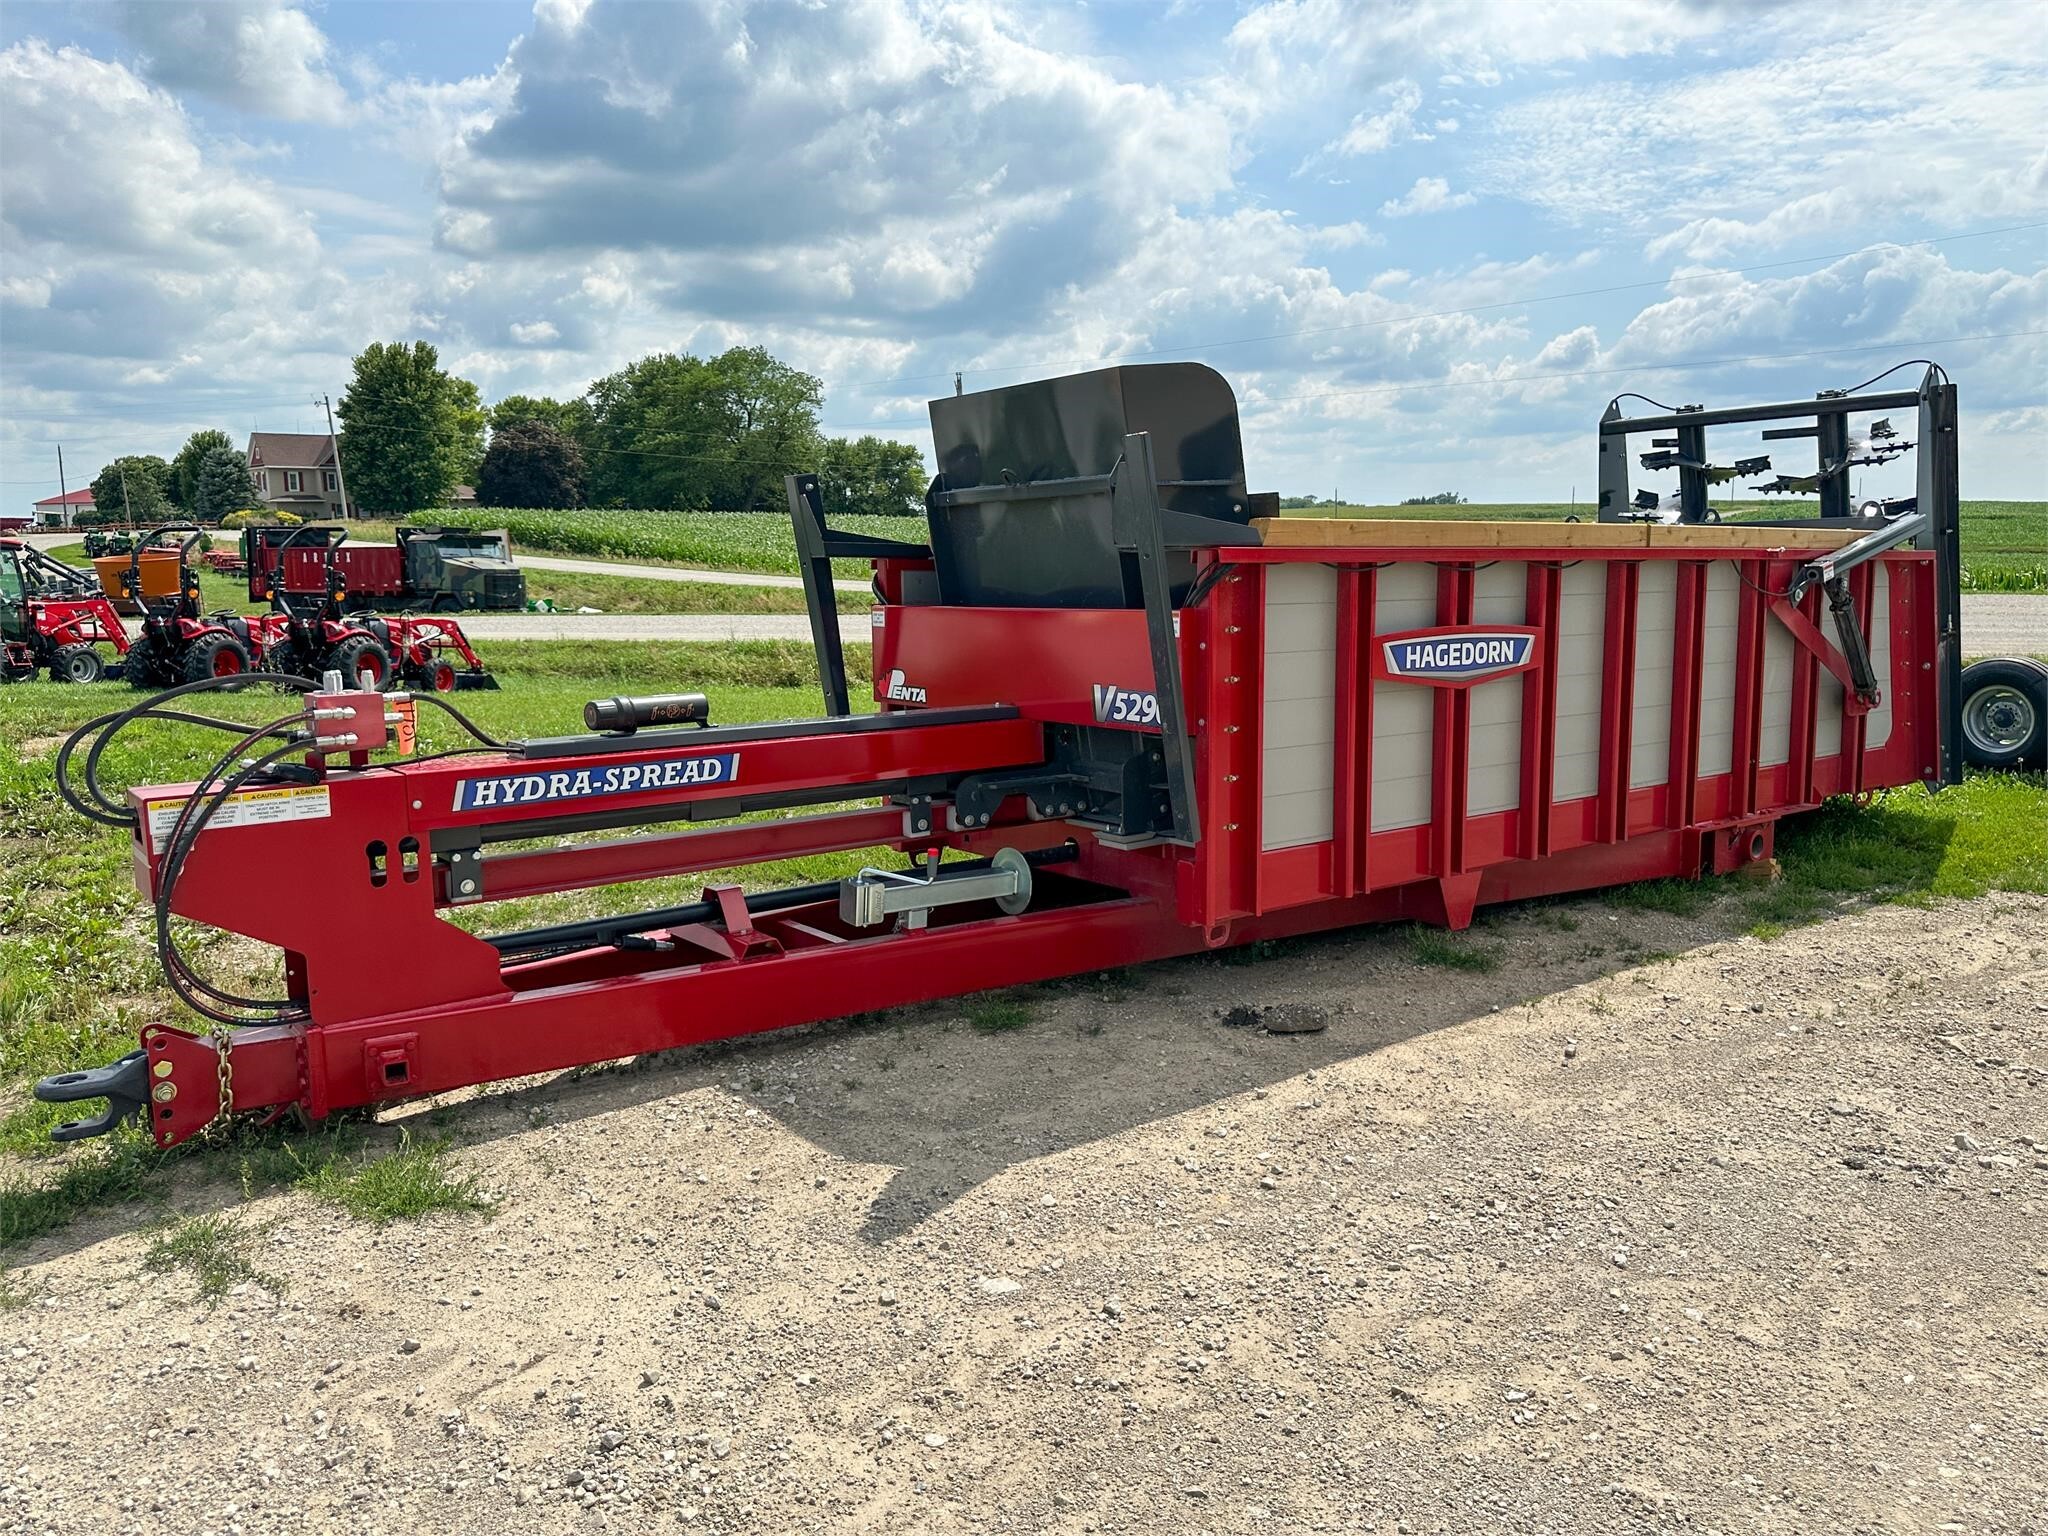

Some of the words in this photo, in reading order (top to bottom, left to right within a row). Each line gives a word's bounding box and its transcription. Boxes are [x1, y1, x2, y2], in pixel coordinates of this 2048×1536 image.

[1406, 640, 1514, 669] HAGEDORN
[887, 669, 927, 703] PENTA
[1093, 684, 1162, 724] V529
[472, 758, 722, 806] HYDRA-SPREAD
[164, 801, 189, 809] CAUTIO
